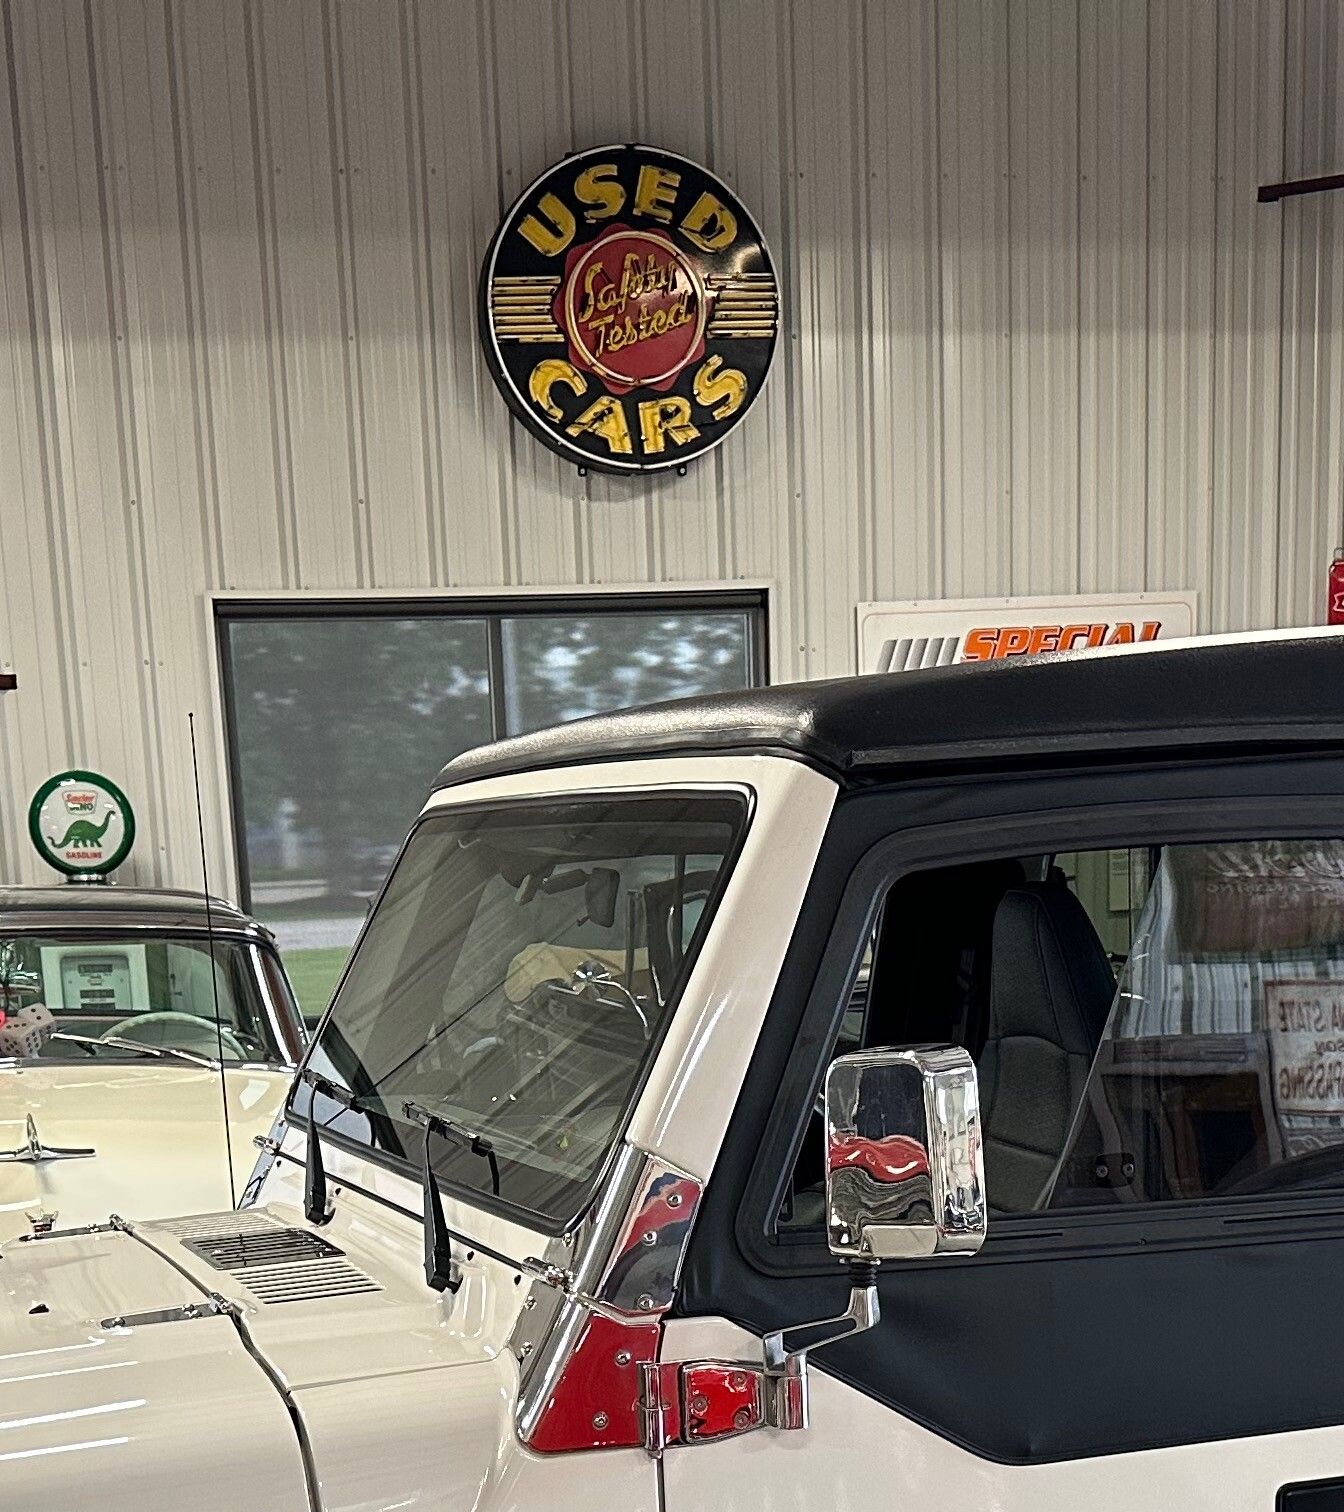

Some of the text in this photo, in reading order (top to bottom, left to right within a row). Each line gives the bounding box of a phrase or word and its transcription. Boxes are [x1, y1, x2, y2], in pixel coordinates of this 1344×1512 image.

[517, 163, 738, 258] USED
[578, 252, 679, 322] Safety
[587, 290, 694, 359] Tested
[528, 354, 749, 455] CARS
